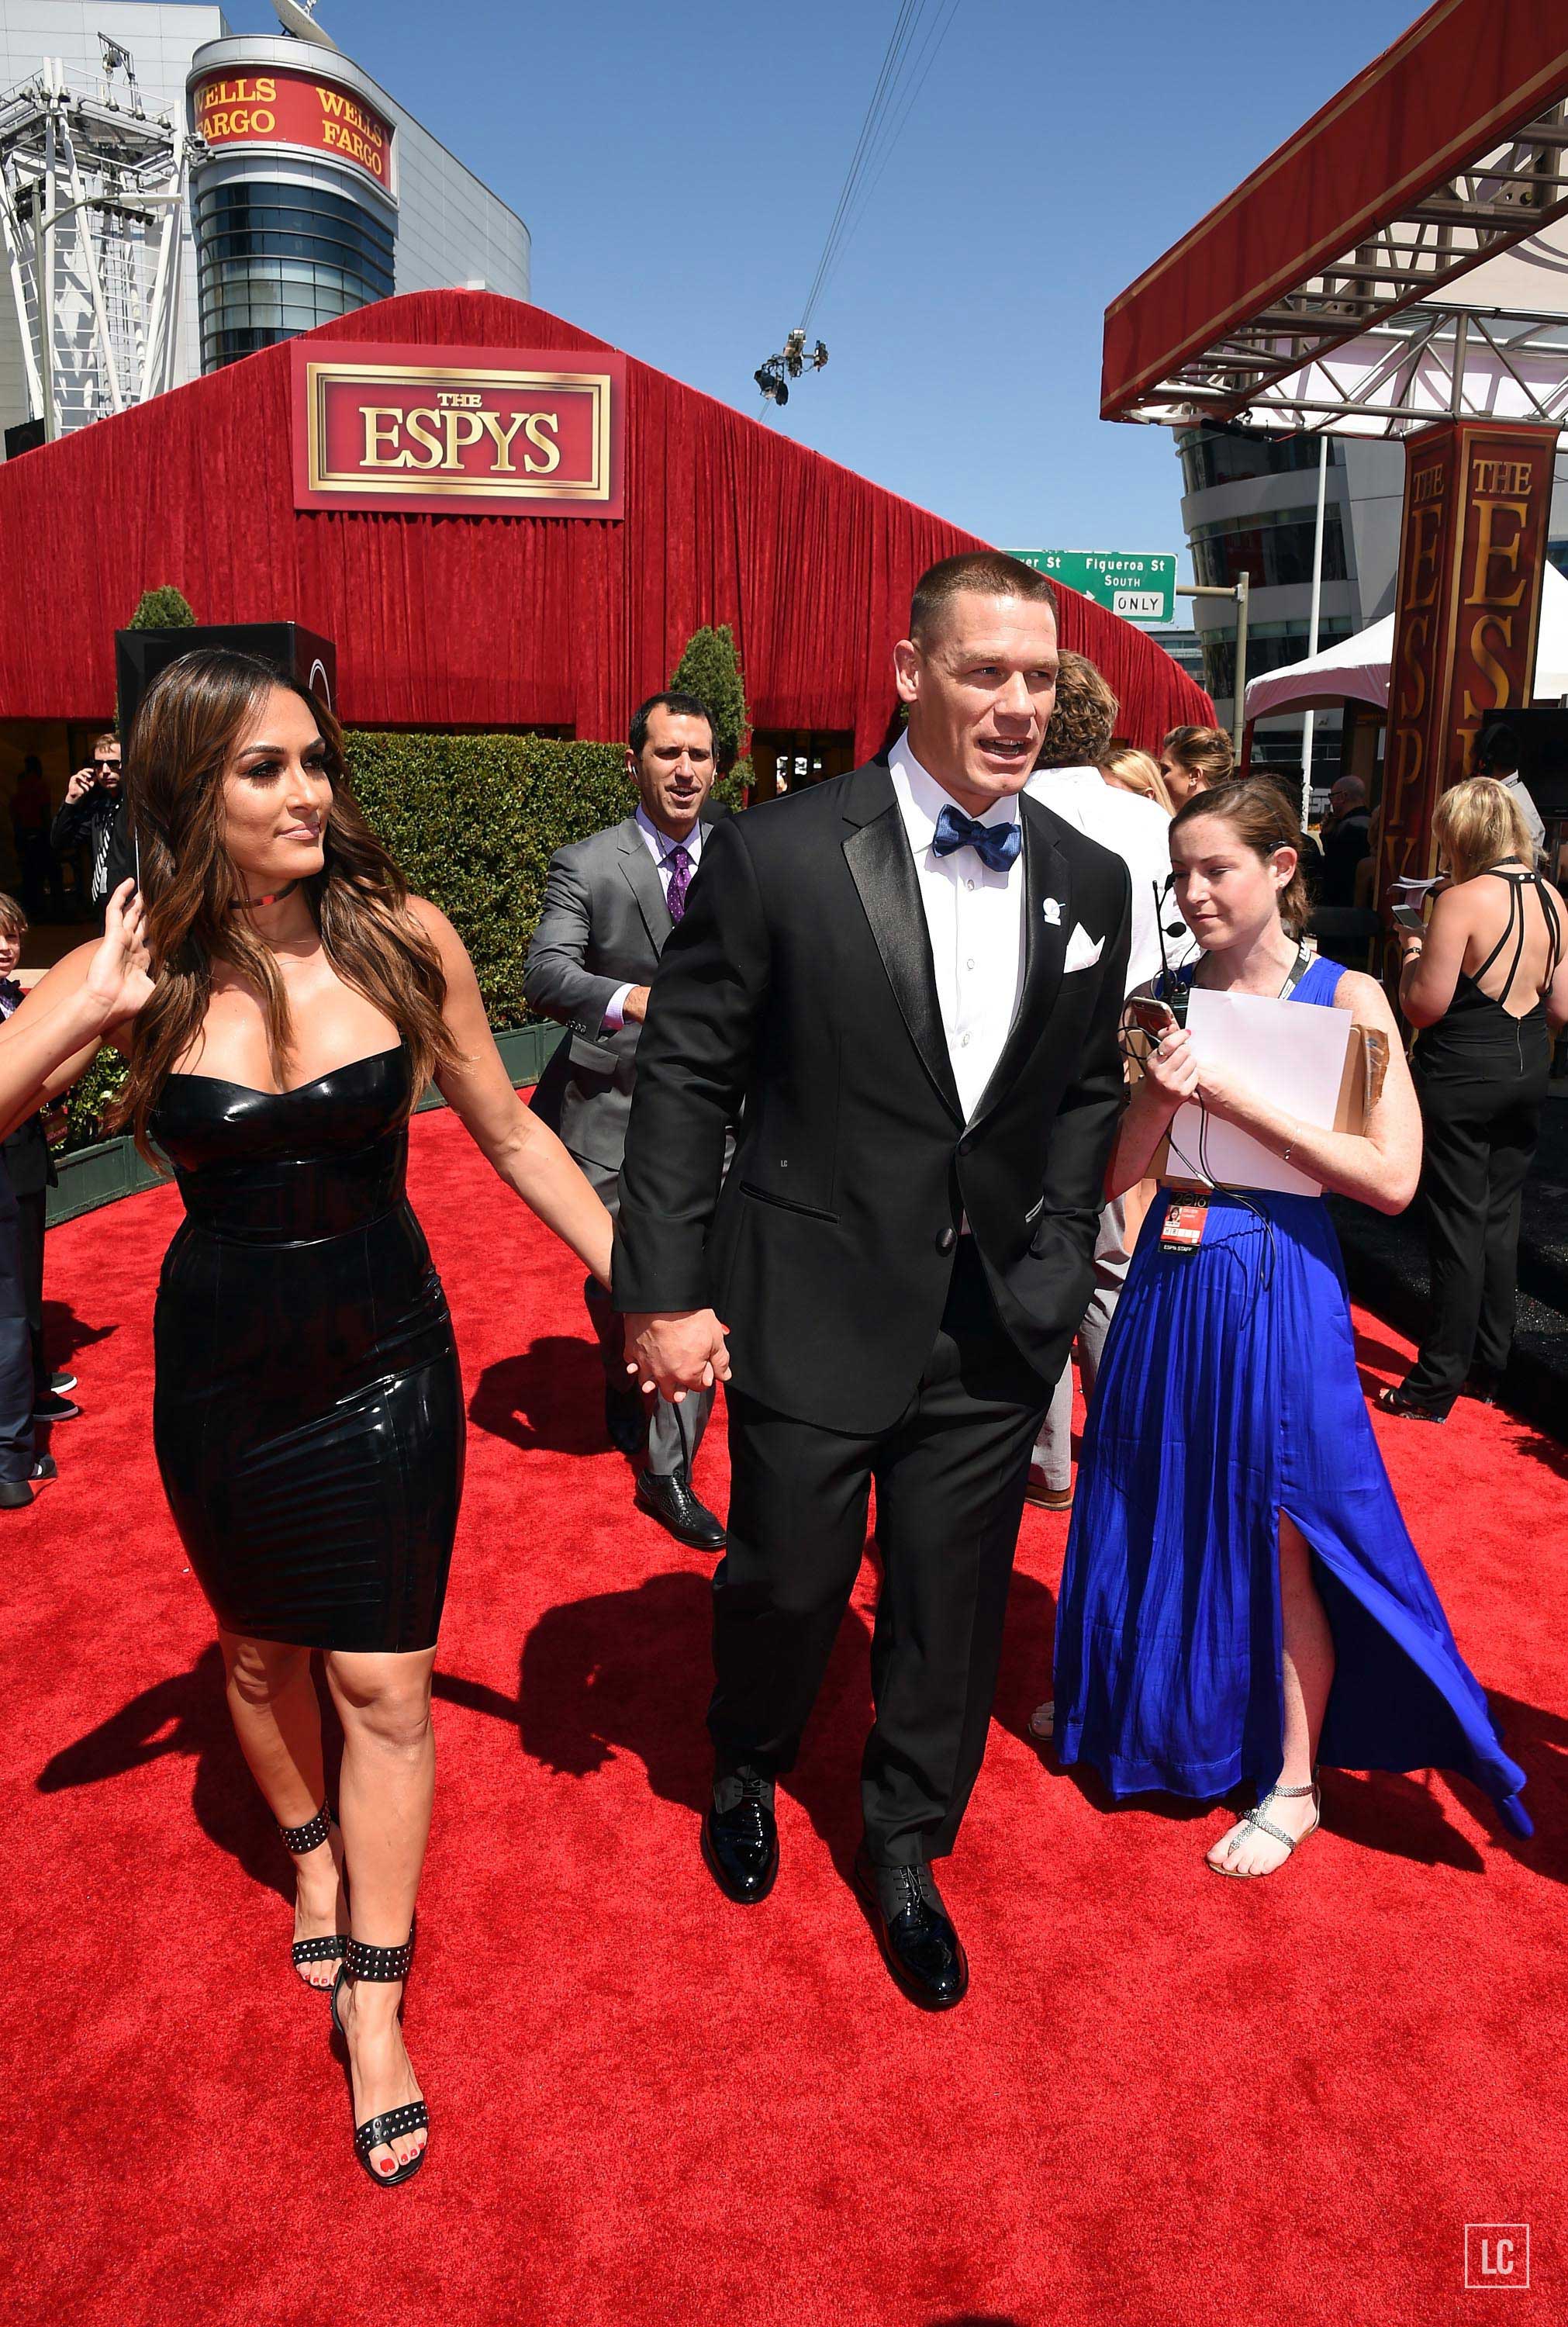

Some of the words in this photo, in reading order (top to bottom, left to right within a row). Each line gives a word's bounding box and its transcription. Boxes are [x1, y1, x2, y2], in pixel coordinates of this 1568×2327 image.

[315, 86, 382, 148] WELLS
[322, 119, 382, 175] FARGO
[437, 392, 483, 409] THE
[358, 406, 561, 473] ESPYS
[1413, 463, 1445, 503] THE
[1472, 458, 1532, 496] THE
[1046, 557, 1061, 568] St
[1086, 558, 1144, 572] Figueroa
[1151, 559, 1165, 572] St
[1104, 575, 1141, 587] SOUTH
[1117, 596, 1159, 610] ONLY
